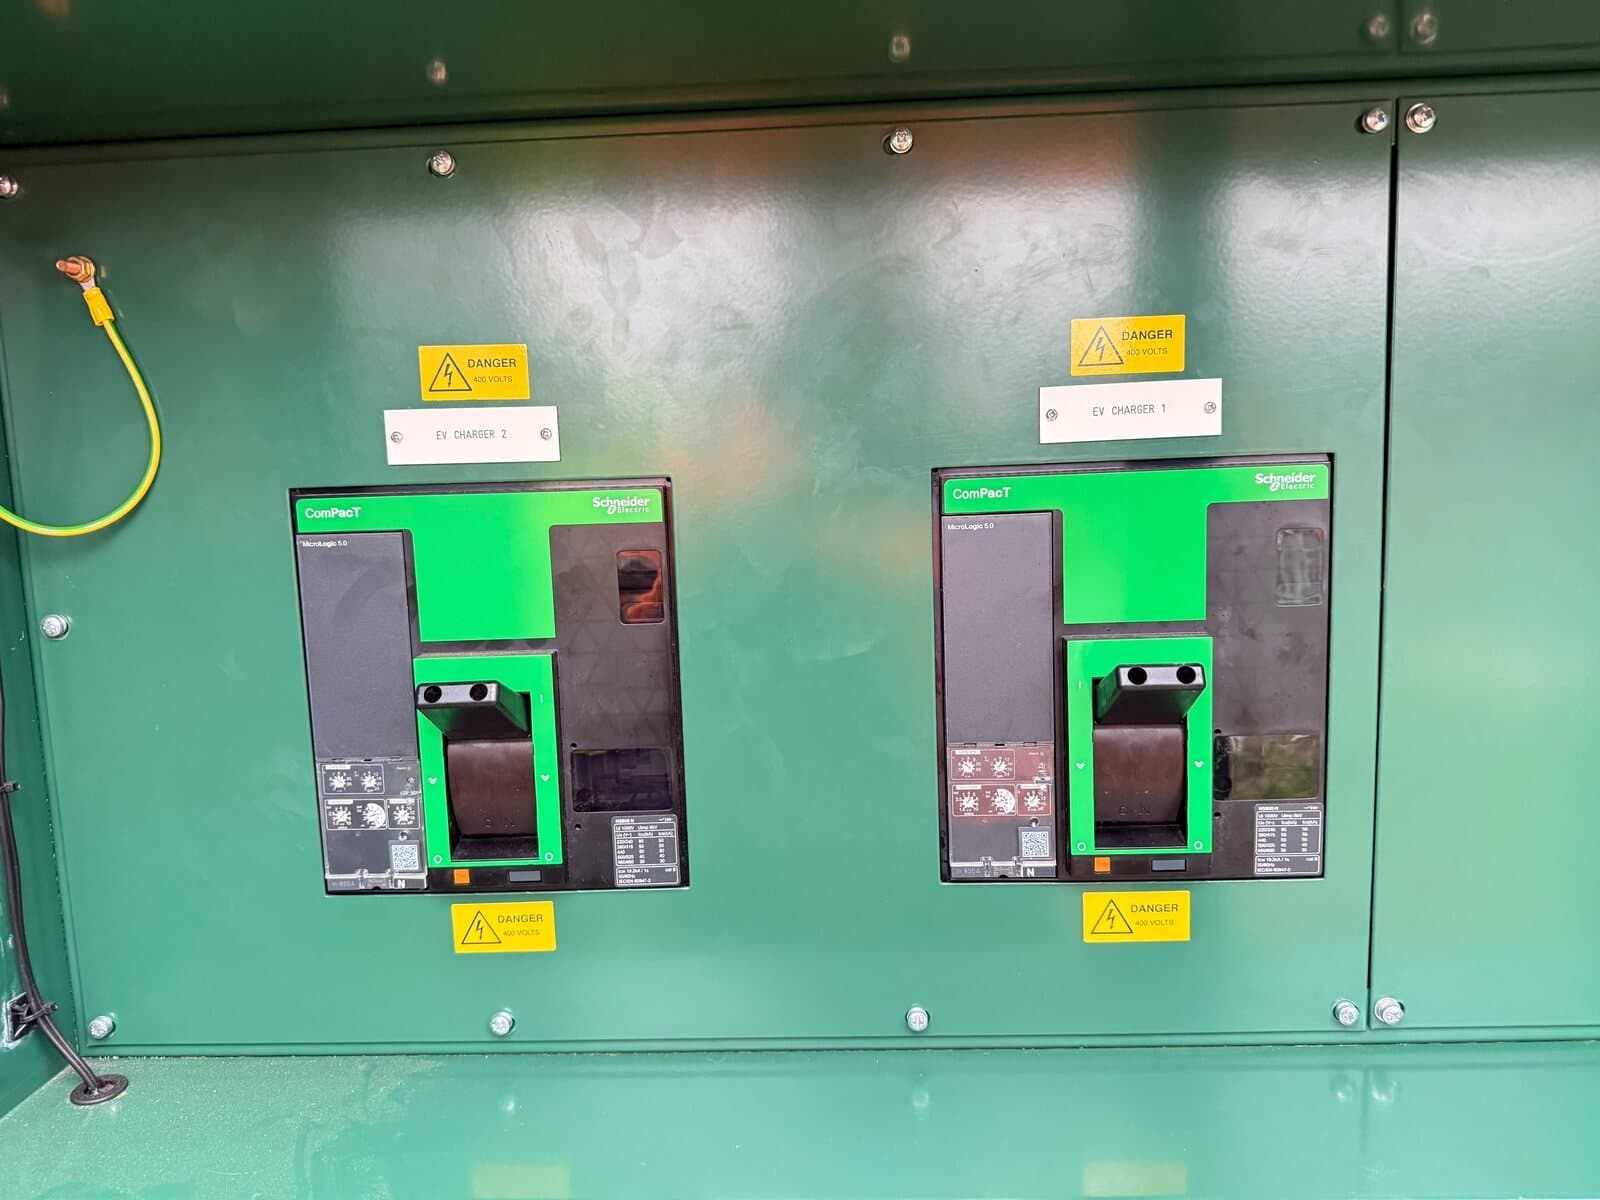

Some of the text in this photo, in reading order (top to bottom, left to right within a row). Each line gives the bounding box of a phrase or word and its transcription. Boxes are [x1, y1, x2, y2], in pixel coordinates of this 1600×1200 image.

[1121, 329, 1173, 341] DANGER
[1126, 348, 1140, 356] 400
[467, 358, 516, 368] DANGER
[1092, 404, 1166, 417] EV CHARGER 1
[436, 429, 507, 440] EV CHARGER 2
[1255, 472, 1316, 484] Schneider
[1280, 482, 1315, 490] Electric
[952, 486, 1012, 499] ComPacT
[592, 496, 651, 507] Schneider
[305, 506, 361, 519] ComPacT
[1026, 868, 1035, 877] N
[397, 880, 405, 888] N
[1130, 903, 1179, 913] DANGER
[497, 914, 543, 923] DANGER
